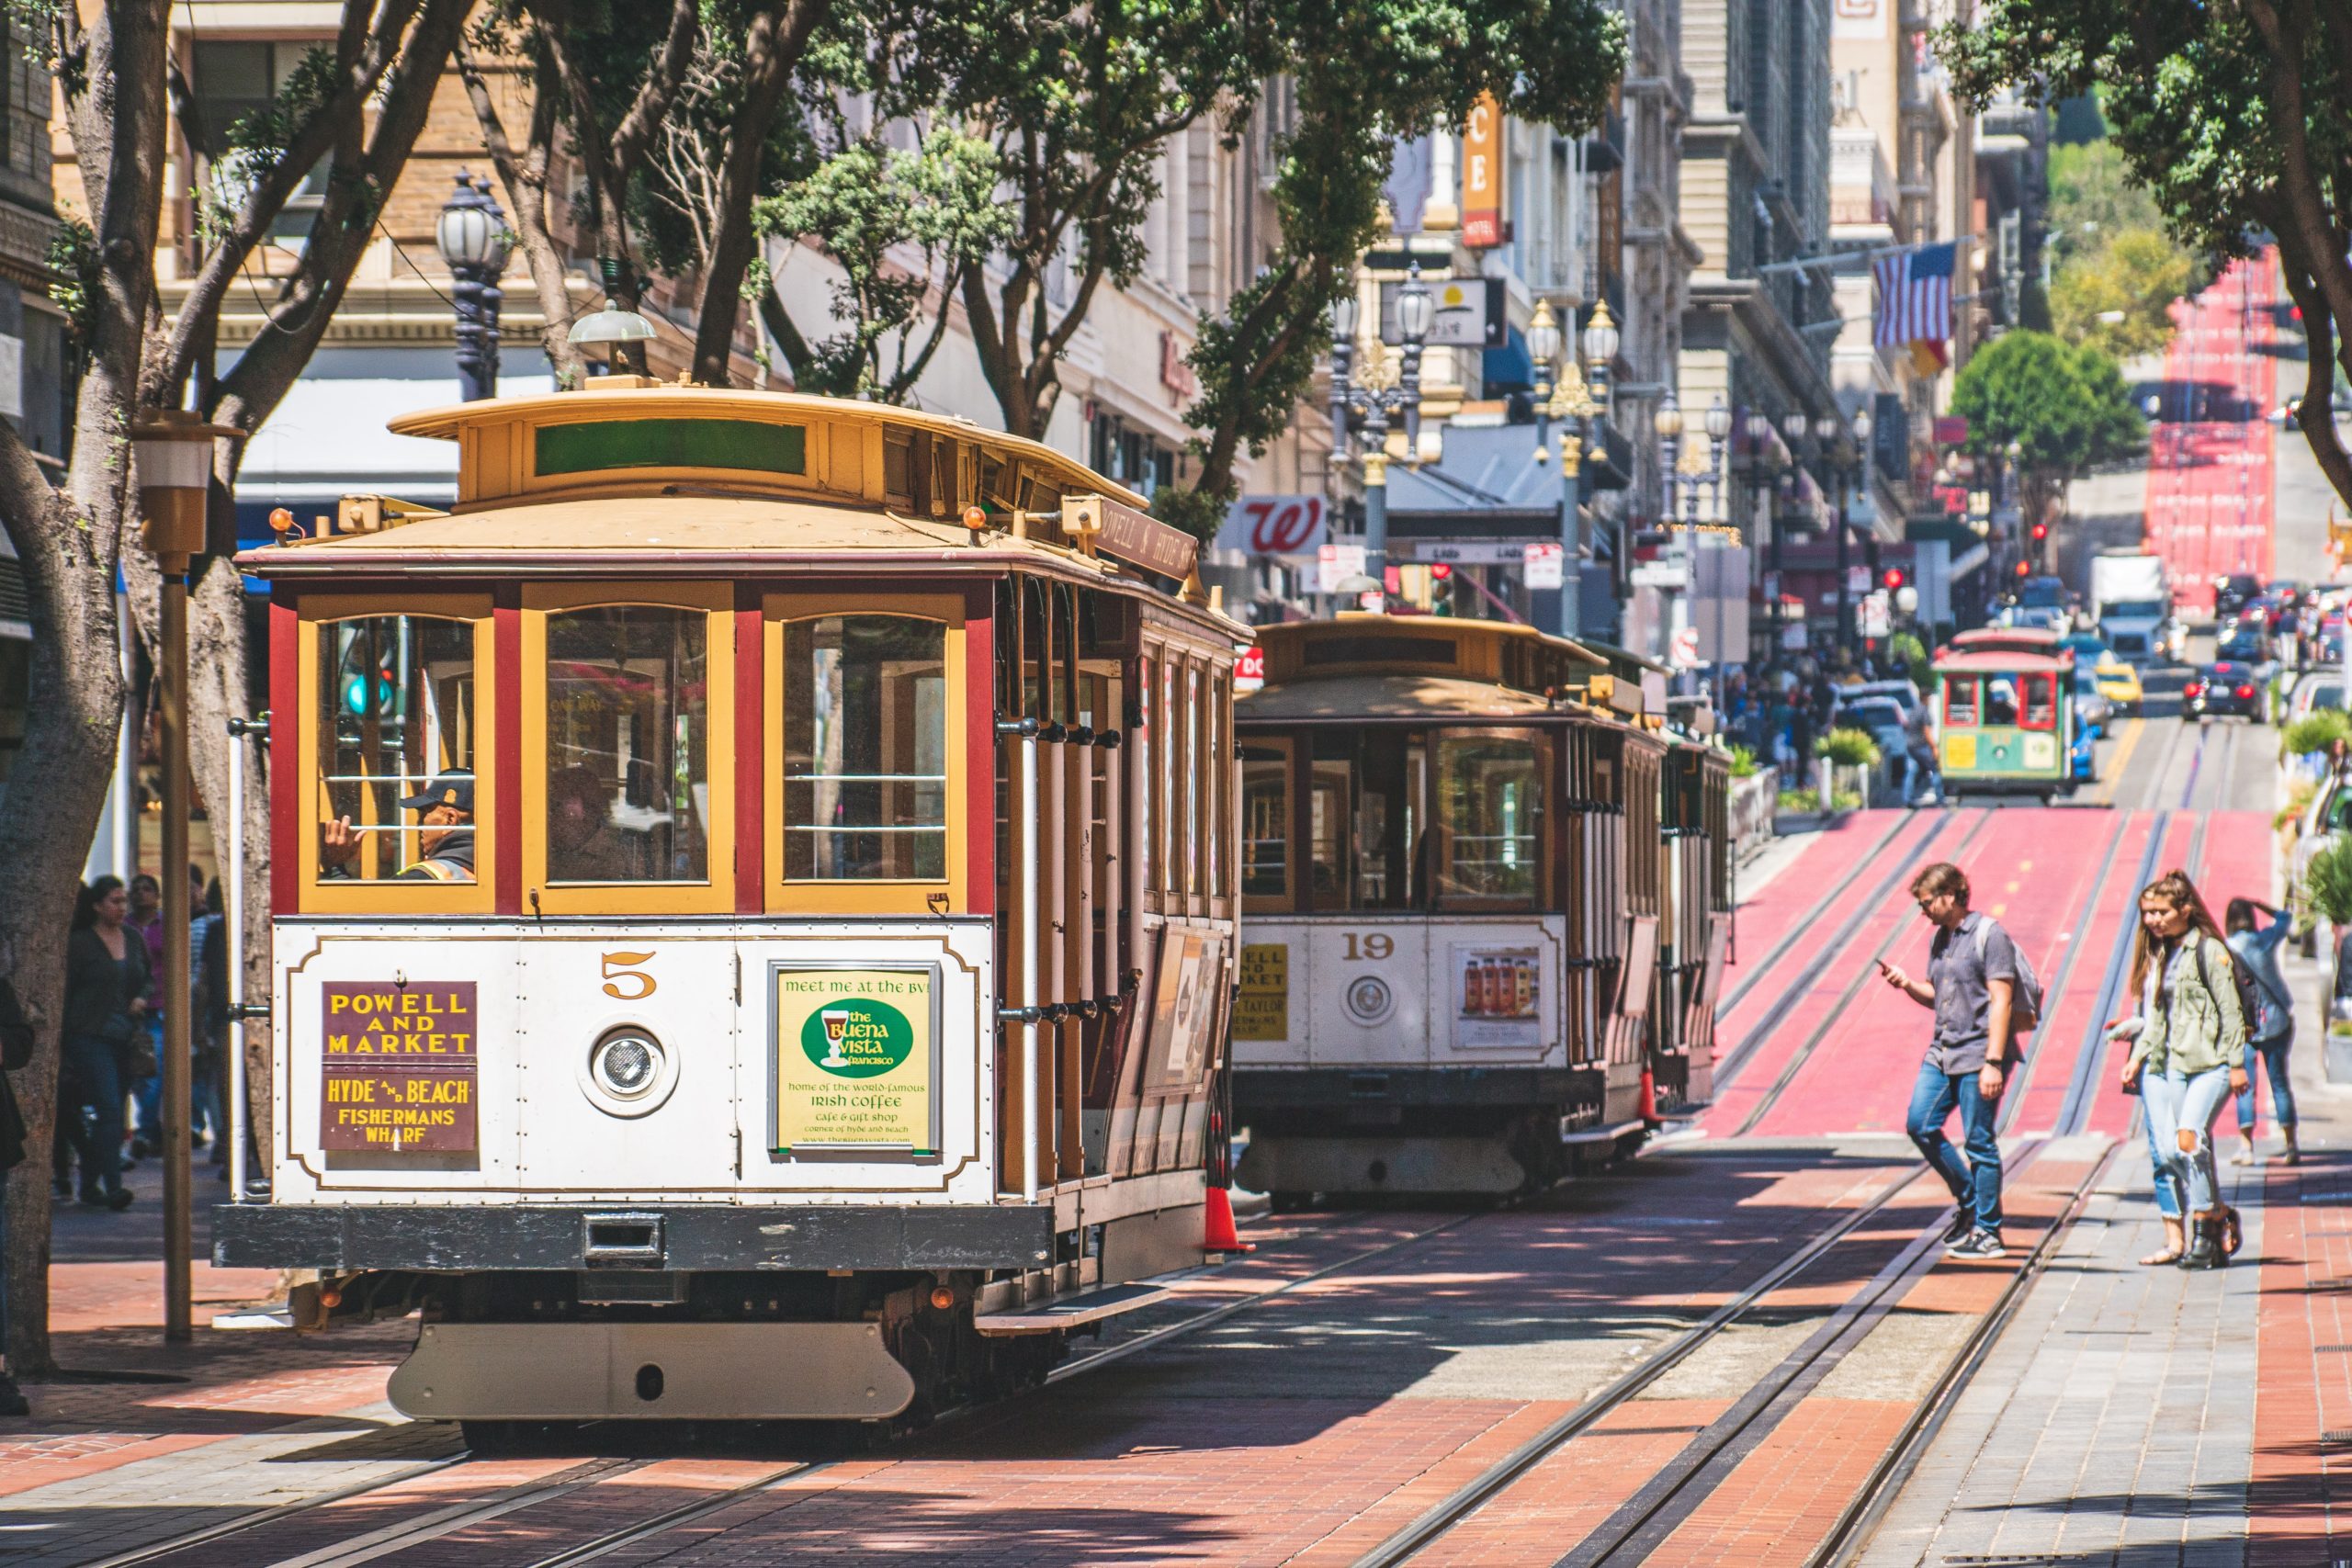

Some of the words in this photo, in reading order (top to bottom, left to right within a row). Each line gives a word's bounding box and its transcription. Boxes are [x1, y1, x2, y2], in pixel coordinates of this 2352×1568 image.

[1153, 533, 1180, 566] HYDE
[1341, 932, 1394, 961] 19
[1245, 952, 1283, 964] ELL
[602, 951, 657, 1000] 5
[330, 994, 468, 1014] POWELL
[367, 1016, 435, 1032] AND
[328, 1033, 470, 1054] MARKET
[327, 1079, 376, 1102] HYDE
[406, 1080, 469, 1103] BEACH
[366, 1127, 426, 1143] WHARF
